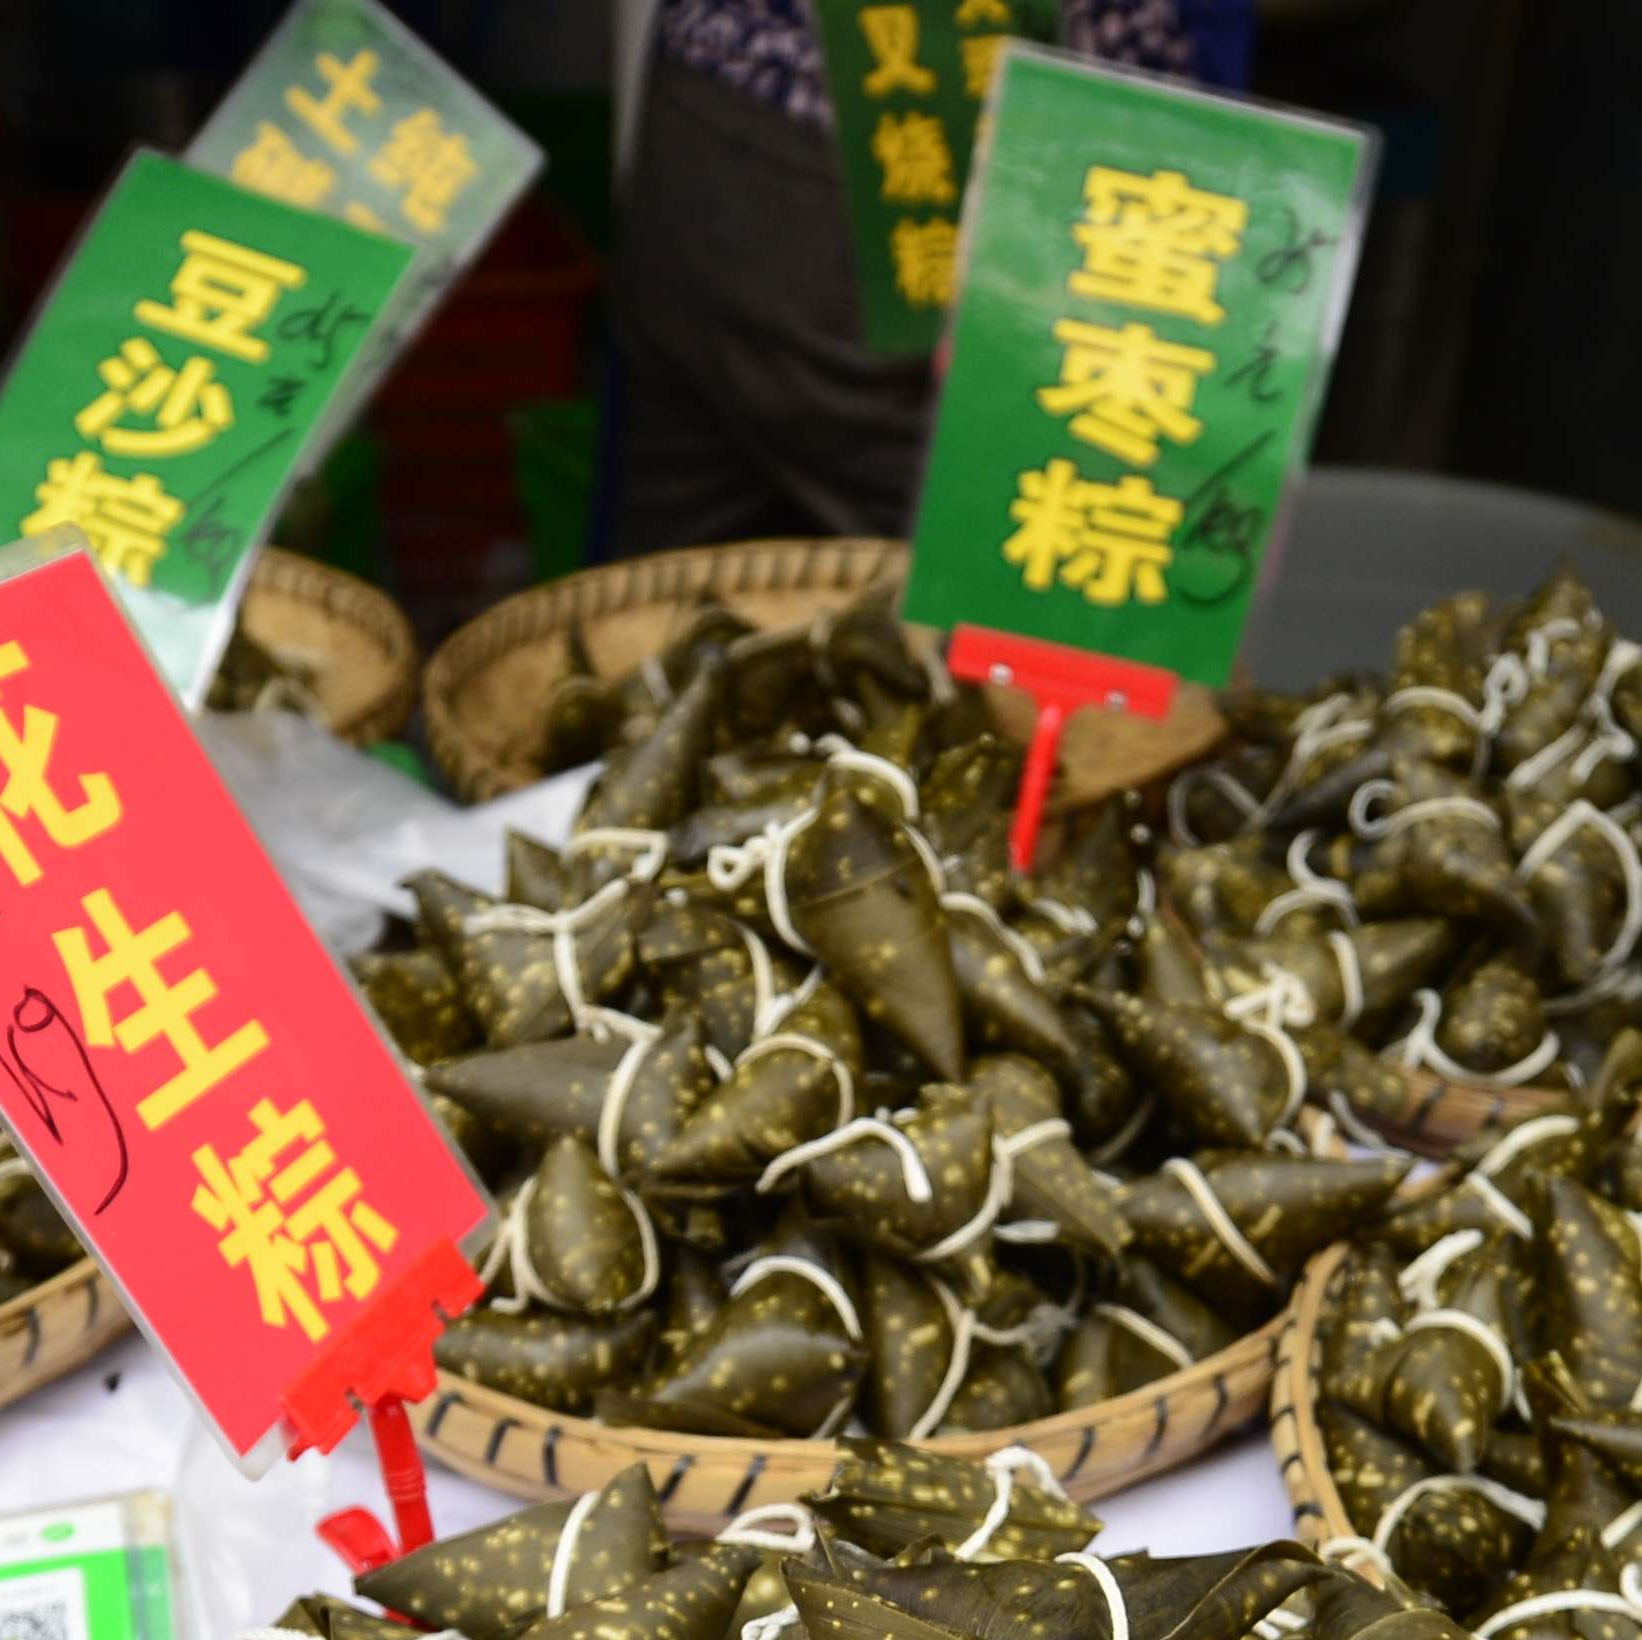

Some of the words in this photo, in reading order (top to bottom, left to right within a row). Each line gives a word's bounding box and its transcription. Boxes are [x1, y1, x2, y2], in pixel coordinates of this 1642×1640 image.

[20, 229, 306, 588] 豆沙粽
[1003, 164, 1250, 607] 蜜枣粽
